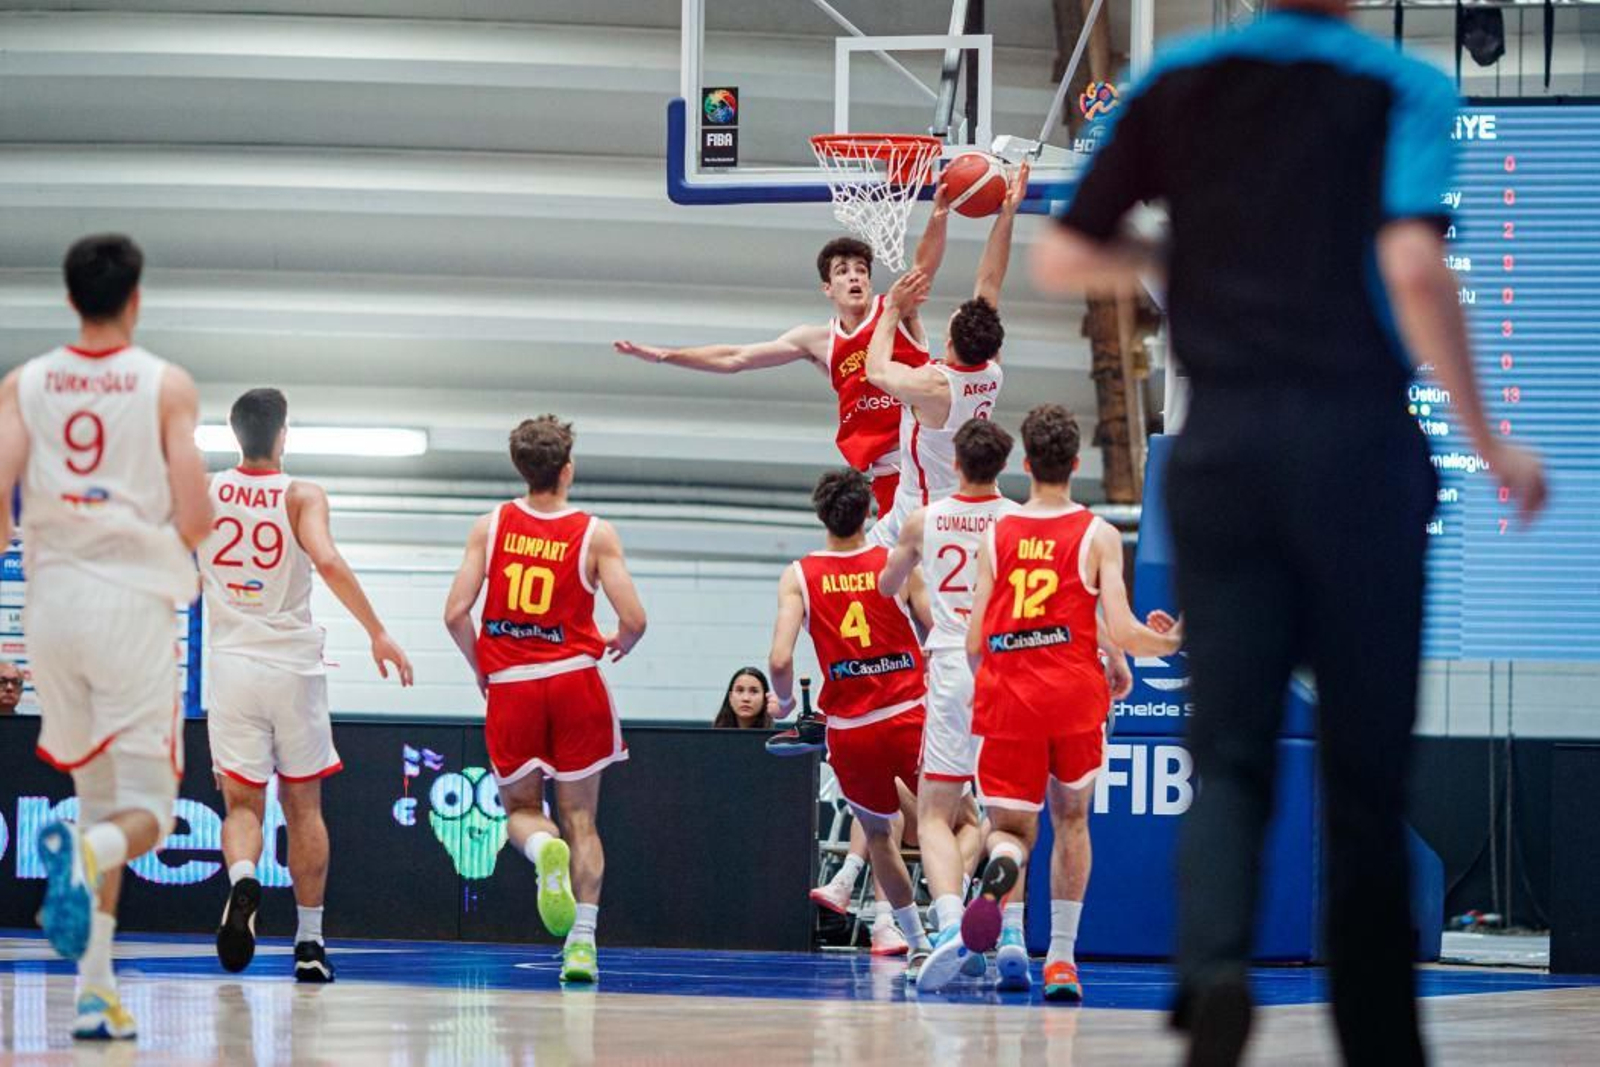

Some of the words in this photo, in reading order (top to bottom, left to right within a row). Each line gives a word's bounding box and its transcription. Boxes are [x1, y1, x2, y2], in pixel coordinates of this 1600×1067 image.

[706, 133, 733, 147] FIBA
[1451, 114, 1497, 139] İYE
[63, 410, 106, 475] 9
[218, 483, 284, 509] ONAT
[212, 516, 284, 570] 29
[503, 532, 569, 562] LLOMPART
[1018, 537, 1057, 561] DÍAZ
[503, 562, 556, 615] 10
[822, 570, 876, 594] ALOCEN
[936, 543, 978, 593] 2
[1008, 568, 1060, 620] 12
[840, 600, 872, 648] 4
[1093, 743, 1194, 816] FIB
